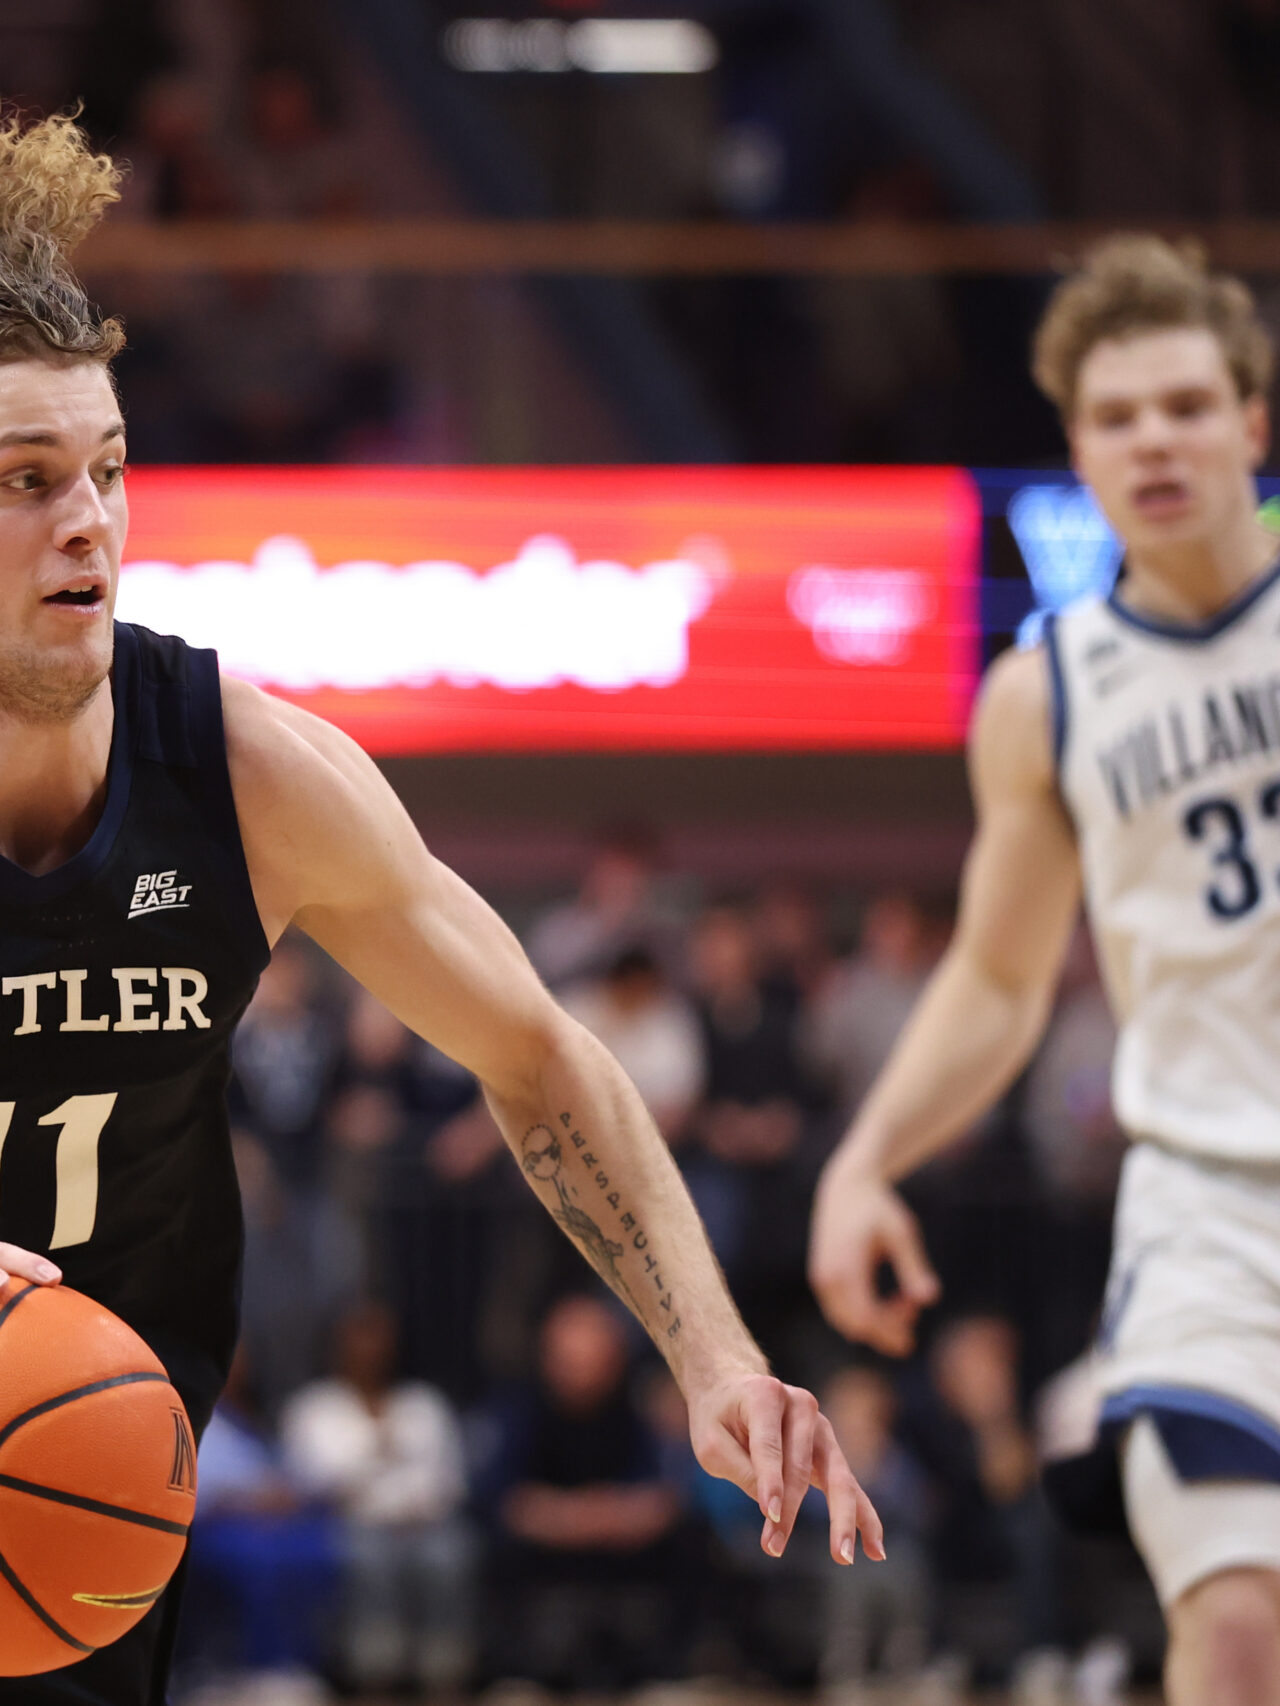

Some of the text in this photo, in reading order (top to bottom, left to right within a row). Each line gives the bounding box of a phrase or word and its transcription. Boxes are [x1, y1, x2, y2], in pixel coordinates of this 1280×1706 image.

[134, 869, 178, 893] BIG
[129, 885, 193, 910] EAST
[559, 1111, 682, 1339] PERSPECTIVE
